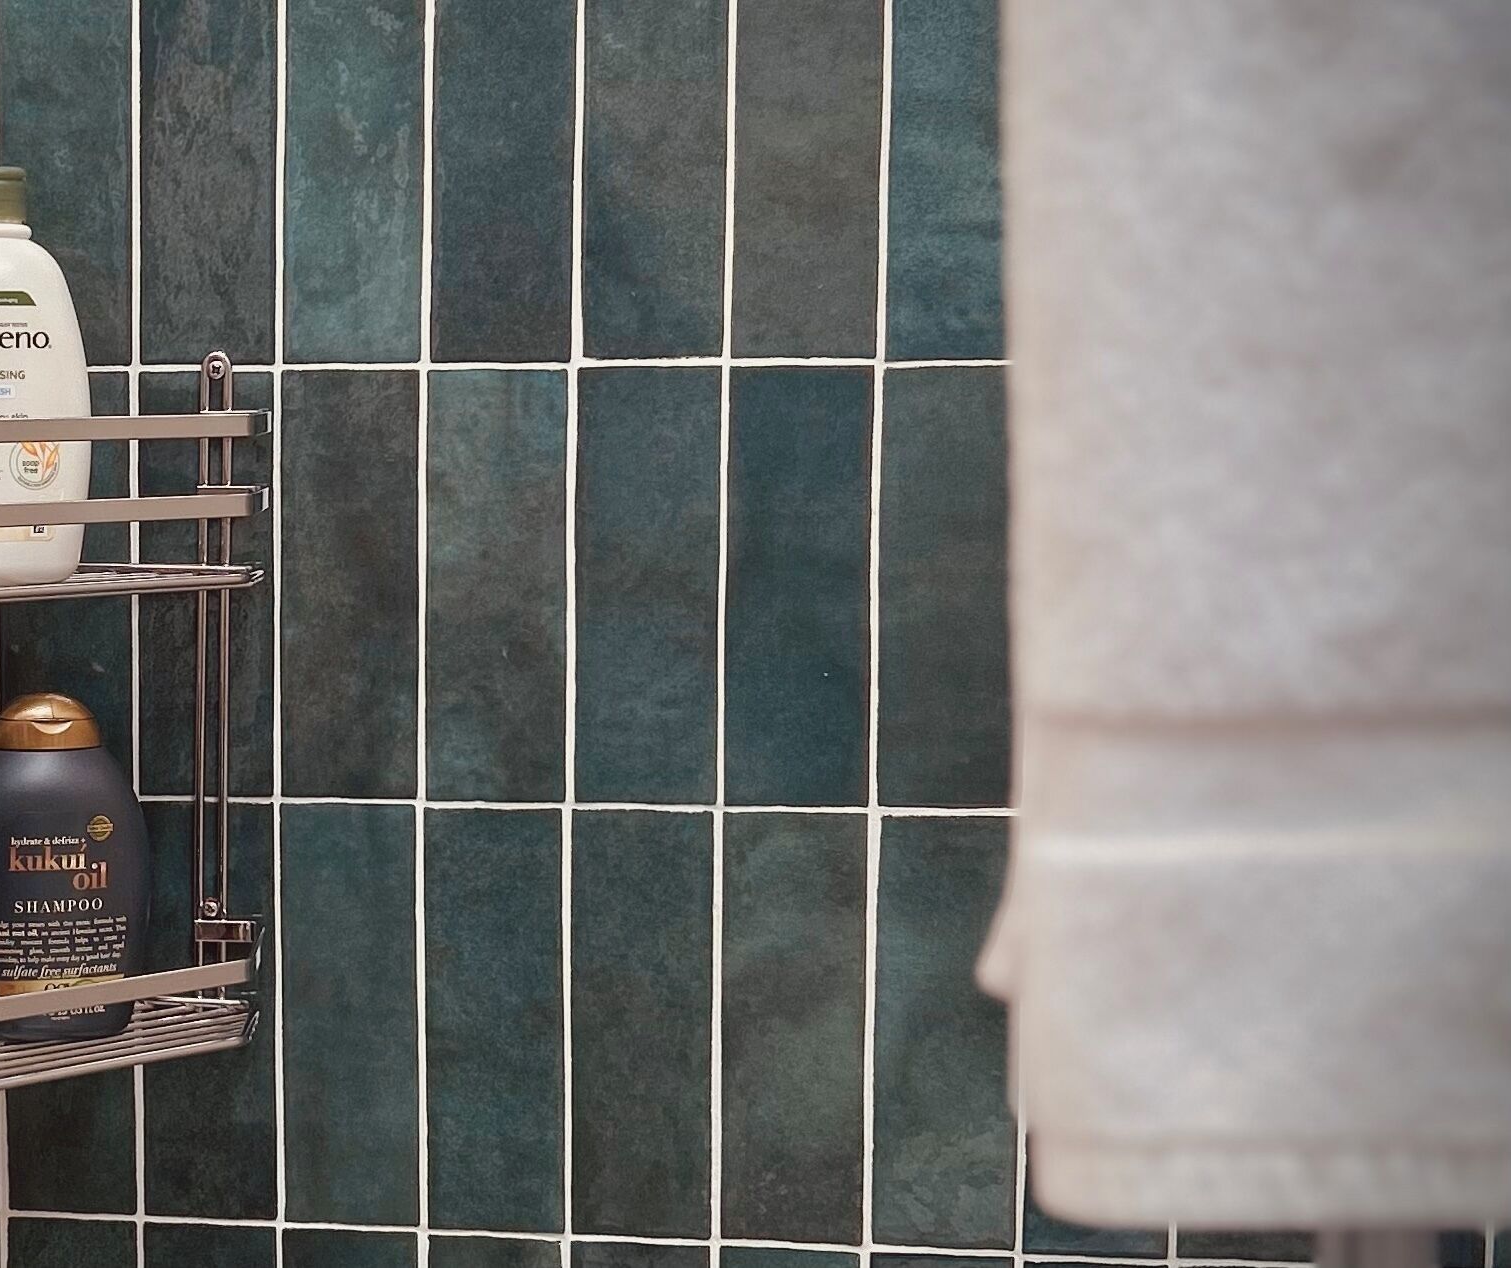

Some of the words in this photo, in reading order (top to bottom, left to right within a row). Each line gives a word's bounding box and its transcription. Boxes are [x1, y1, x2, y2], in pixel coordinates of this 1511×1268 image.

[11, 837, 42, 847] hydrate
[52, 836, 79, 845] defrizz
[72, 862, 107, 890] oil
[14, 898, 103, 914] SHAMPOO
[1, 965, 38, 979] sulfate
[38, 965, 61, 979] free
[63, 963, 117, 977] surfactants
